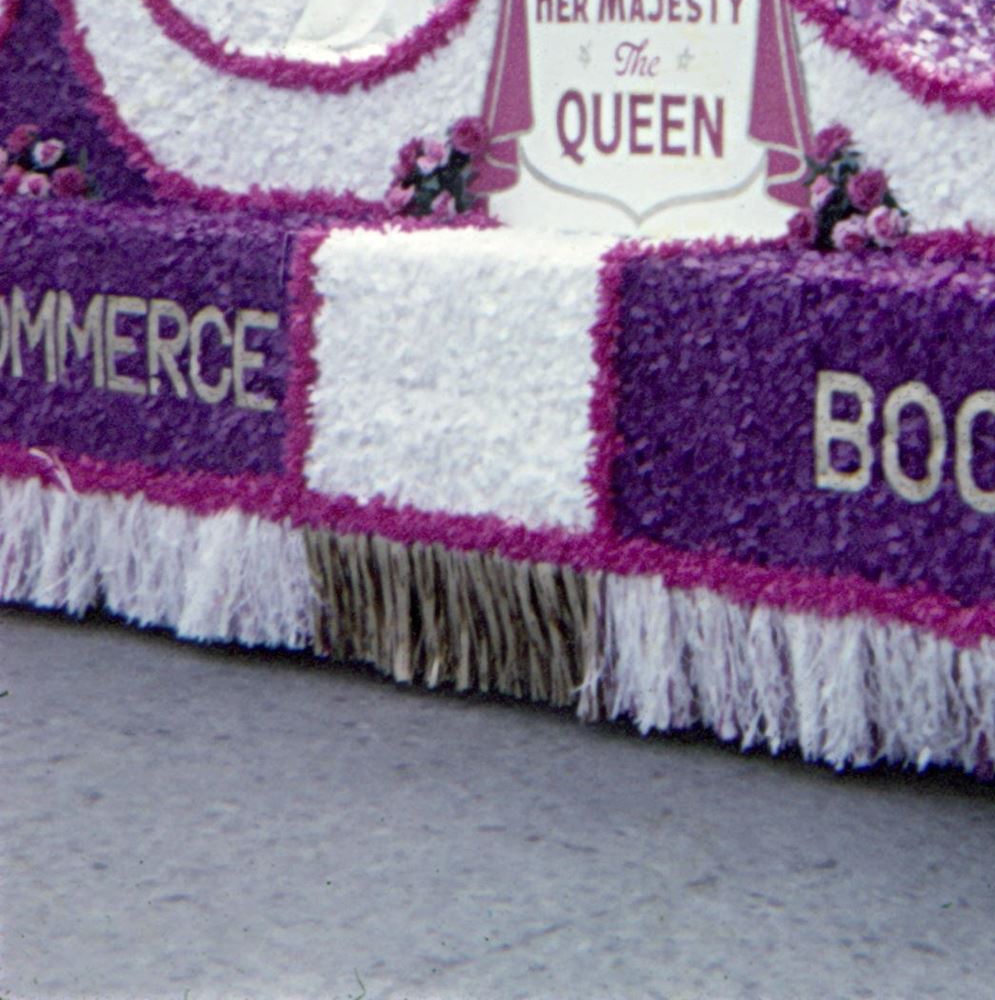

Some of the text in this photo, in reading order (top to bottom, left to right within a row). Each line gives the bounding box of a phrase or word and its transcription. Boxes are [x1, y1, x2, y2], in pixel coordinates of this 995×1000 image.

[614, 38, 661, 77] The
[556, 88, 725, 165] QUEEN
[0, 285, 279, 411] MMERCE
